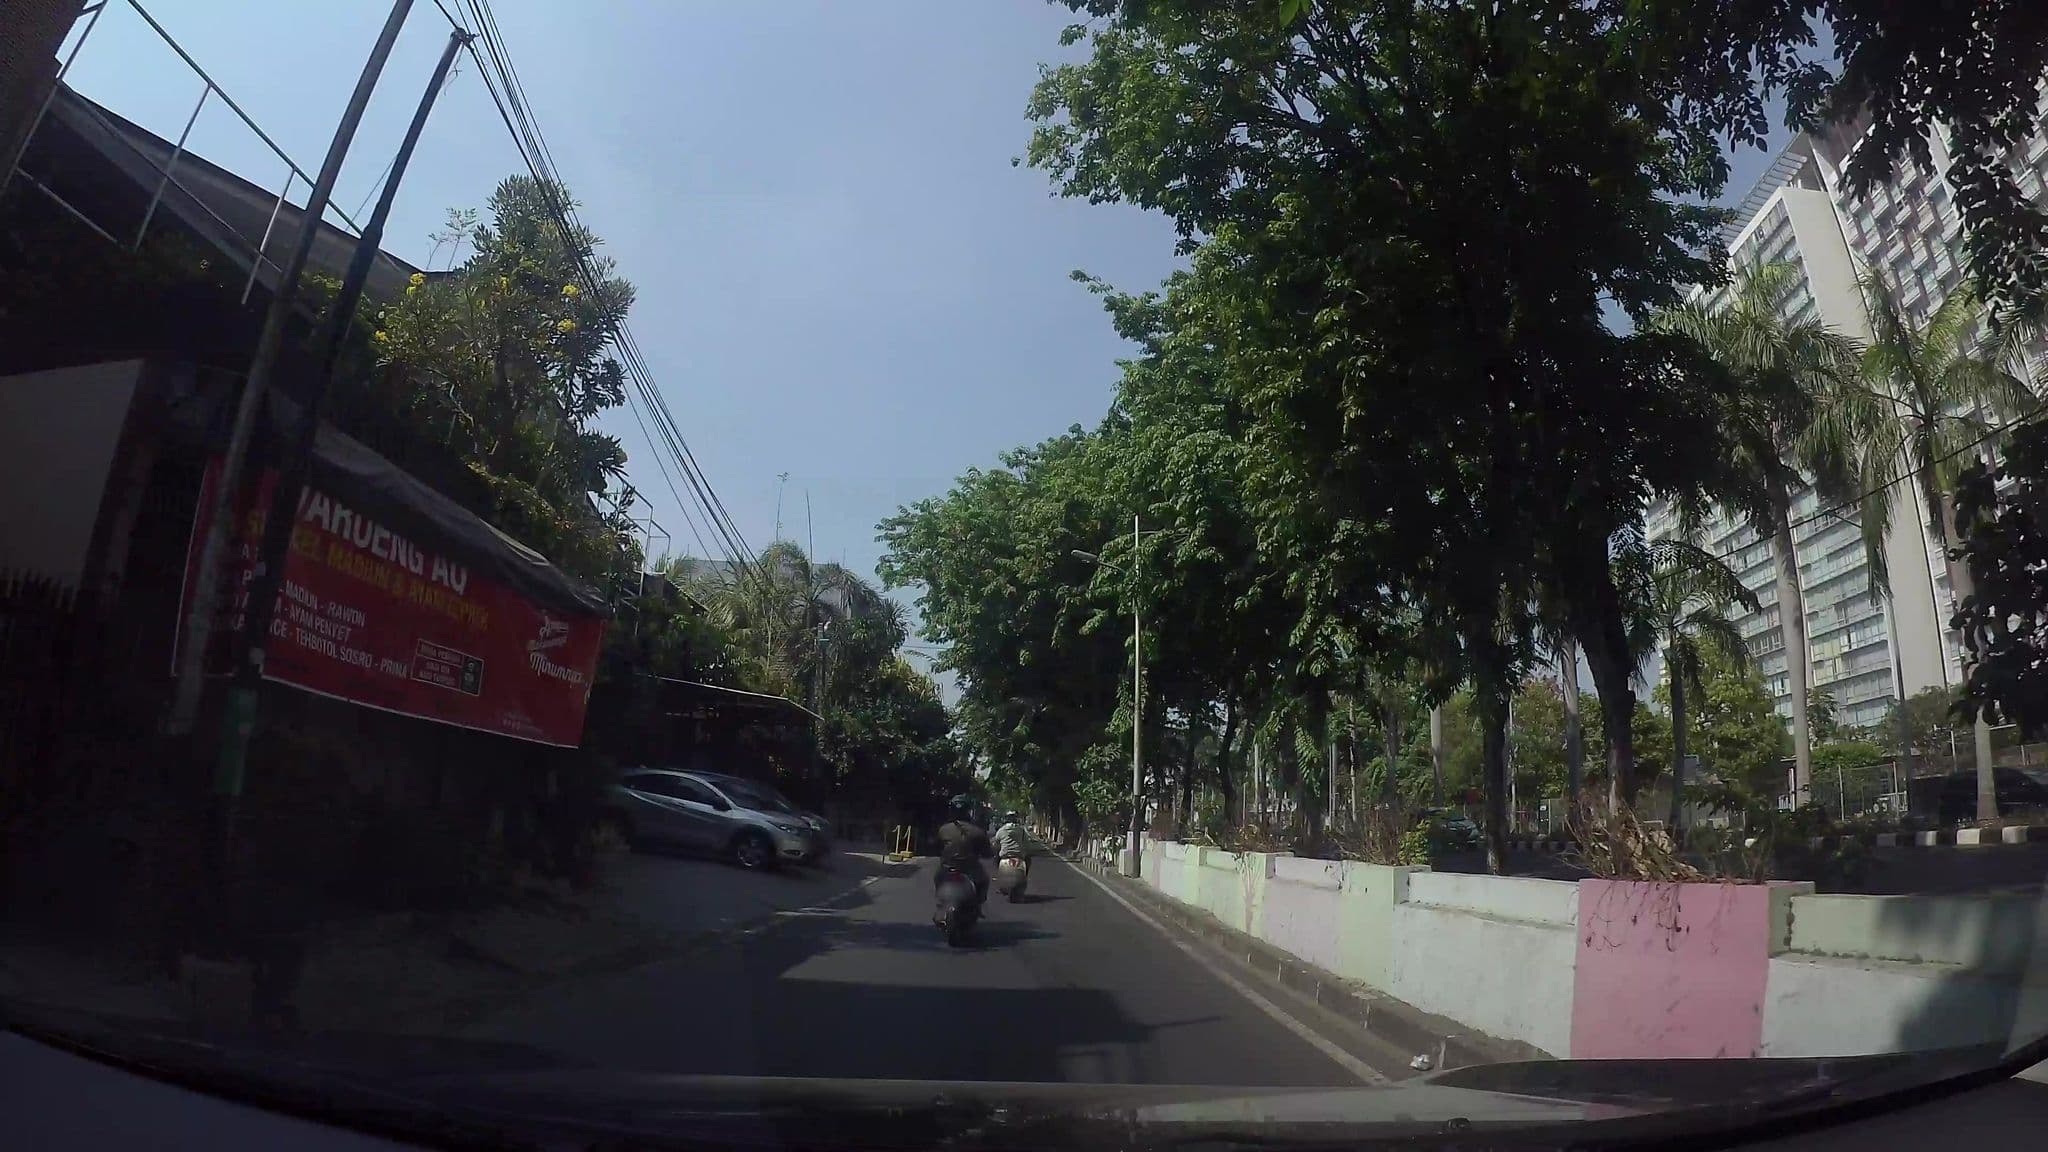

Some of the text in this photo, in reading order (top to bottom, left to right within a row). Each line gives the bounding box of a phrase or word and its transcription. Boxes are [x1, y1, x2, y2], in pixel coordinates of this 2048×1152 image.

[285, 580, 318, 610] MADIUN
[327, 602, 366, 628] RAWON
[289, 603, 314, 629] AYAM
[314, 616, 352, 642] PENYET
[295, 626, 339, 659] TEHBOTOL
[339, 645, 373, 669] SOSRO
[380, 658, 409, 679] PRIMA
